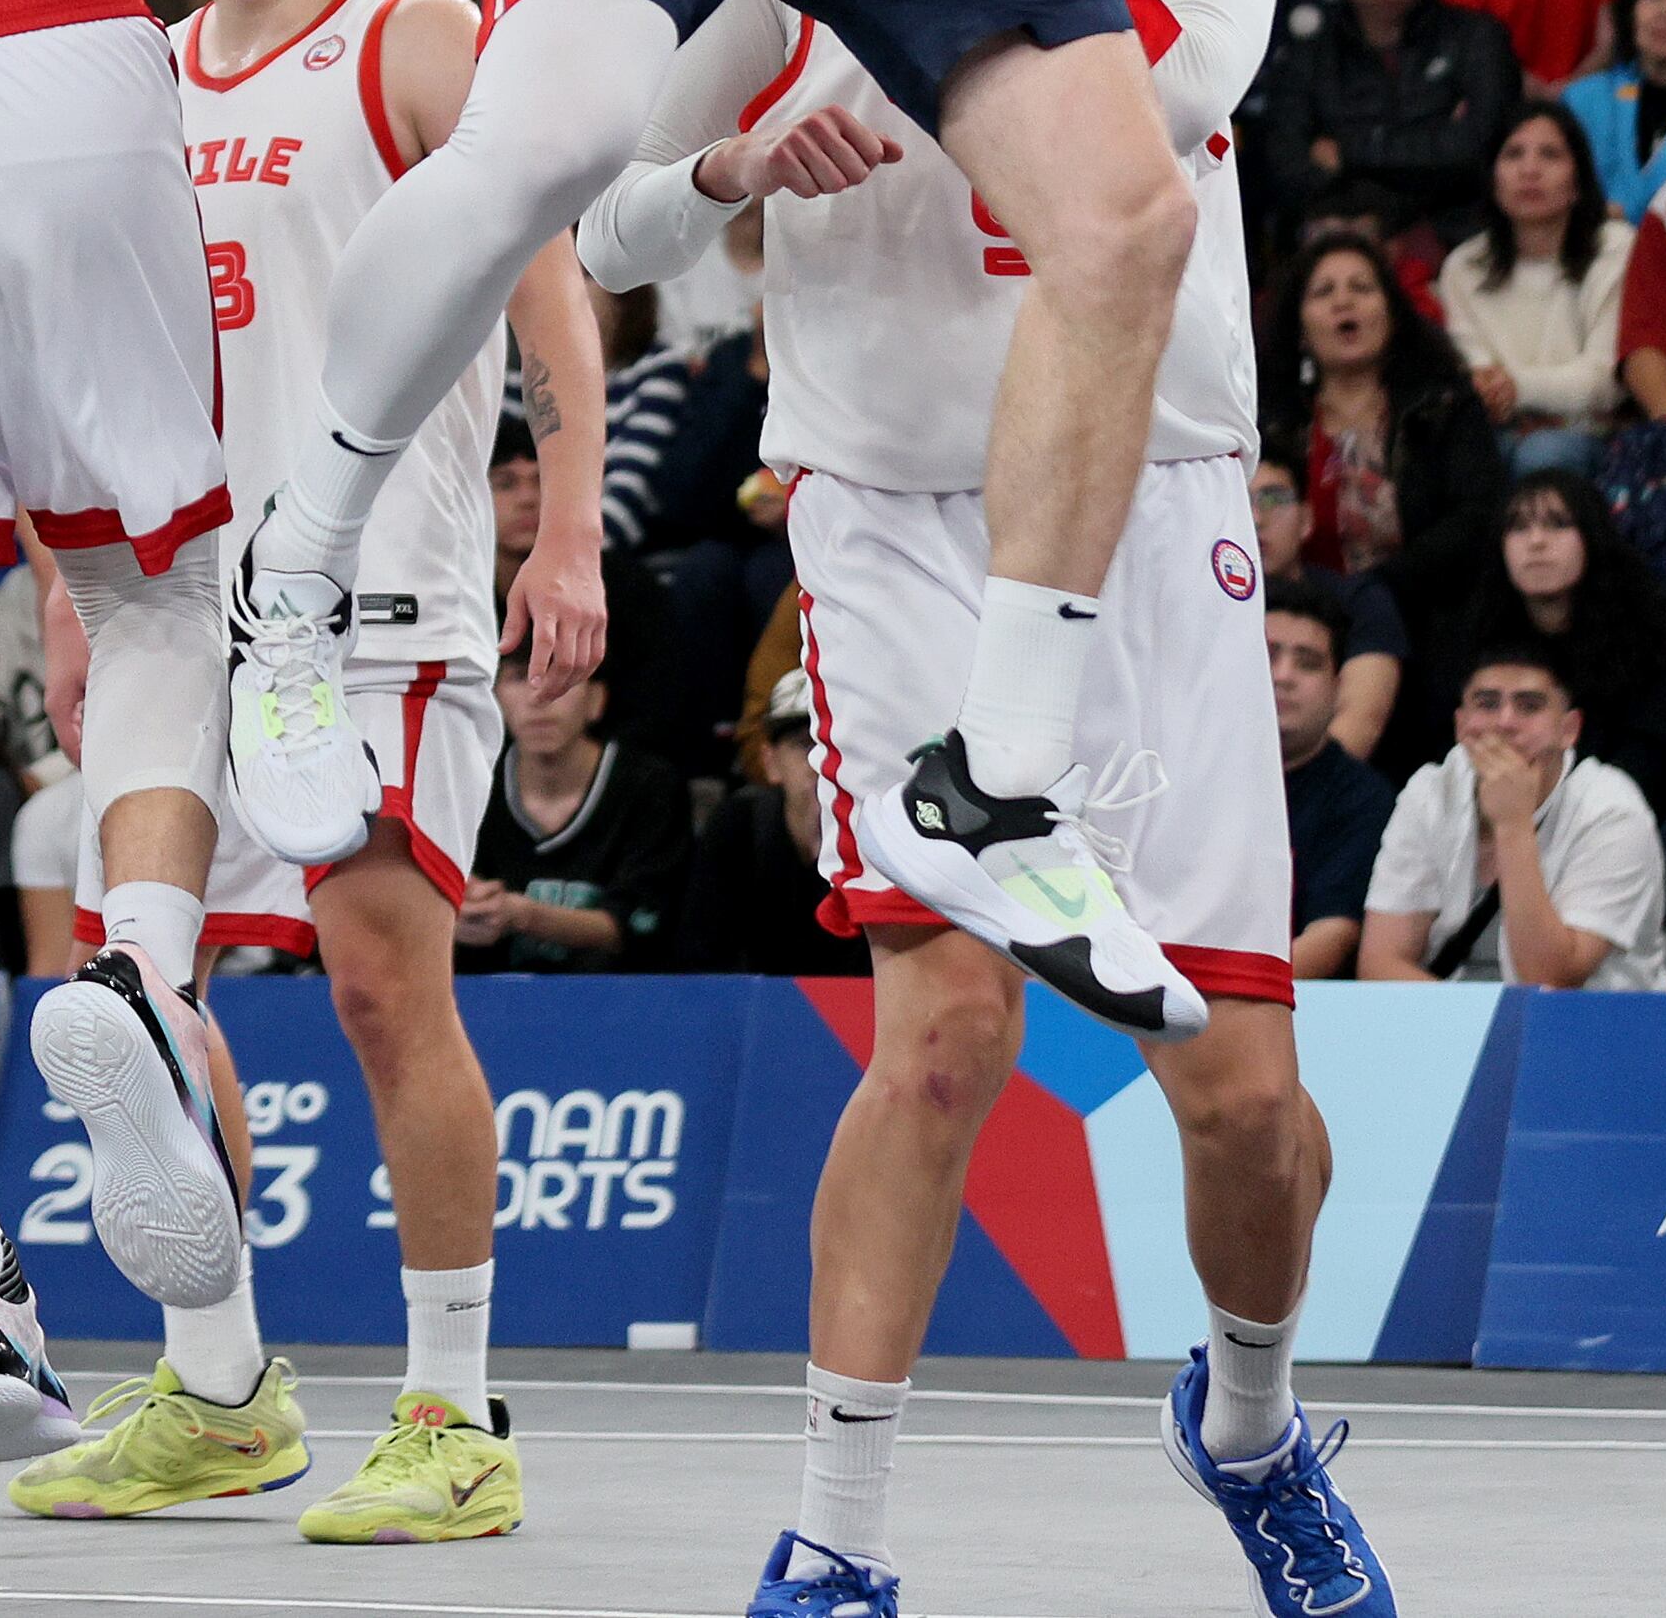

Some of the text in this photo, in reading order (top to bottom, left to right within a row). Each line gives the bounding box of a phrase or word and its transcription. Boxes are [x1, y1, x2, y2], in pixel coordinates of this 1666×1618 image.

[185, 136, 303, 186] ILE
[395, 603, 413, 614] XXL
[495, 1089, 683, 1159] NAM
